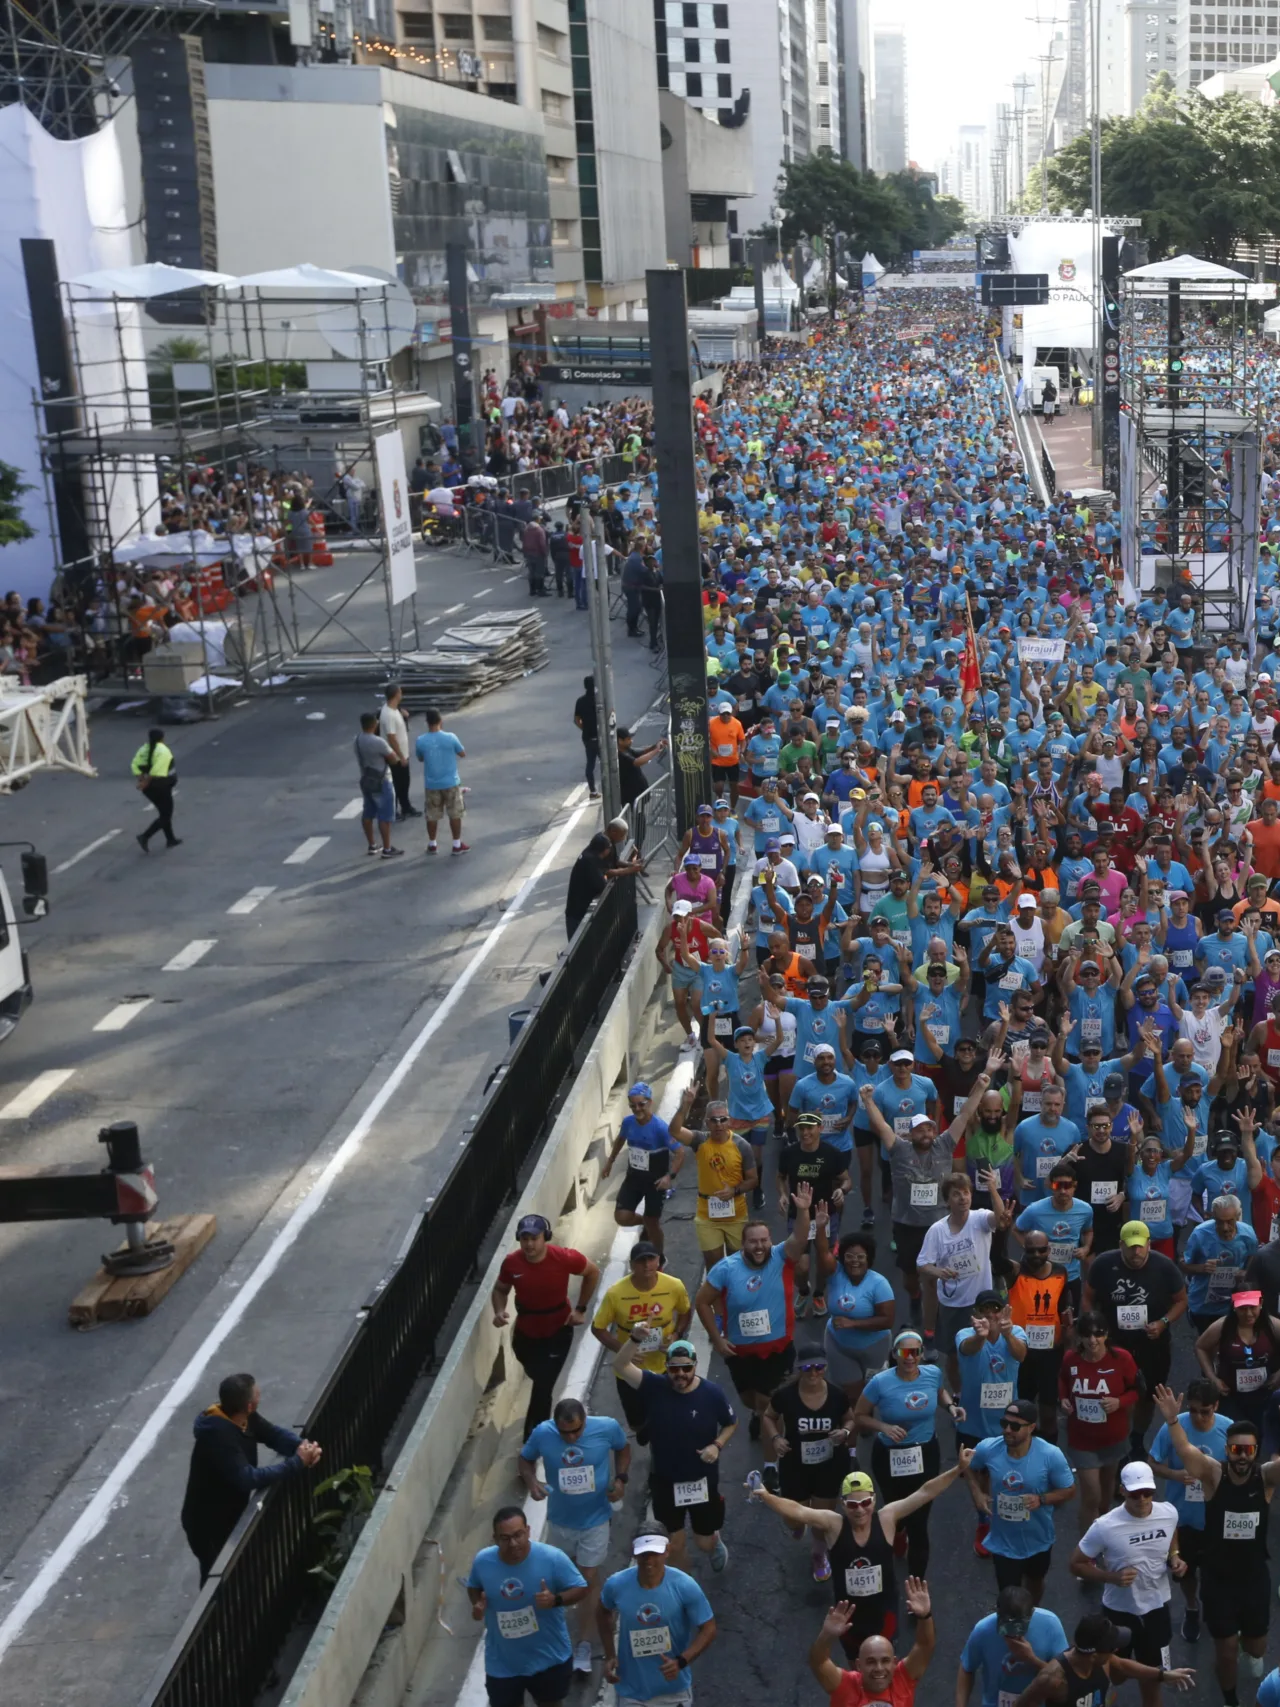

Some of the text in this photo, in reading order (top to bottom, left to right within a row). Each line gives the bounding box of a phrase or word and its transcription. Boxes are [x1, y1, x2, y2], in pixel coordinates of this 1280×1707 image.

[913, 1190, 933, 1198] 17093
[1095, 1188, 1111, 1196] 4493
[710, 1201, 729, 1209] 11089
[1143, 1206, 1162, 1215] 10920
[953, 1260, 971, 1270] 9541
[1121, 1312, 1140, 1322] 5058
[741, 1317, 763, 1328] 25621
[1028, 1332, 1049, 1341] 11857
[1071, 1378, 1110, 1394] ALA
[984, 1390, 1007, 1399] 12387
[798, 1417, 832, 1431] SUB
[891, 1455, 916, 1467] 10464
[562, 1475, 587, 1486] 15991
[676, 1484, 702, 1493] 11644
[1226, 1520, 1253, 1529] 26490
[848, 1574, 875, 1587] 14511
[499, 1615, 530, 1629] 22289
[634, 1635, 664, 1647] 28220
